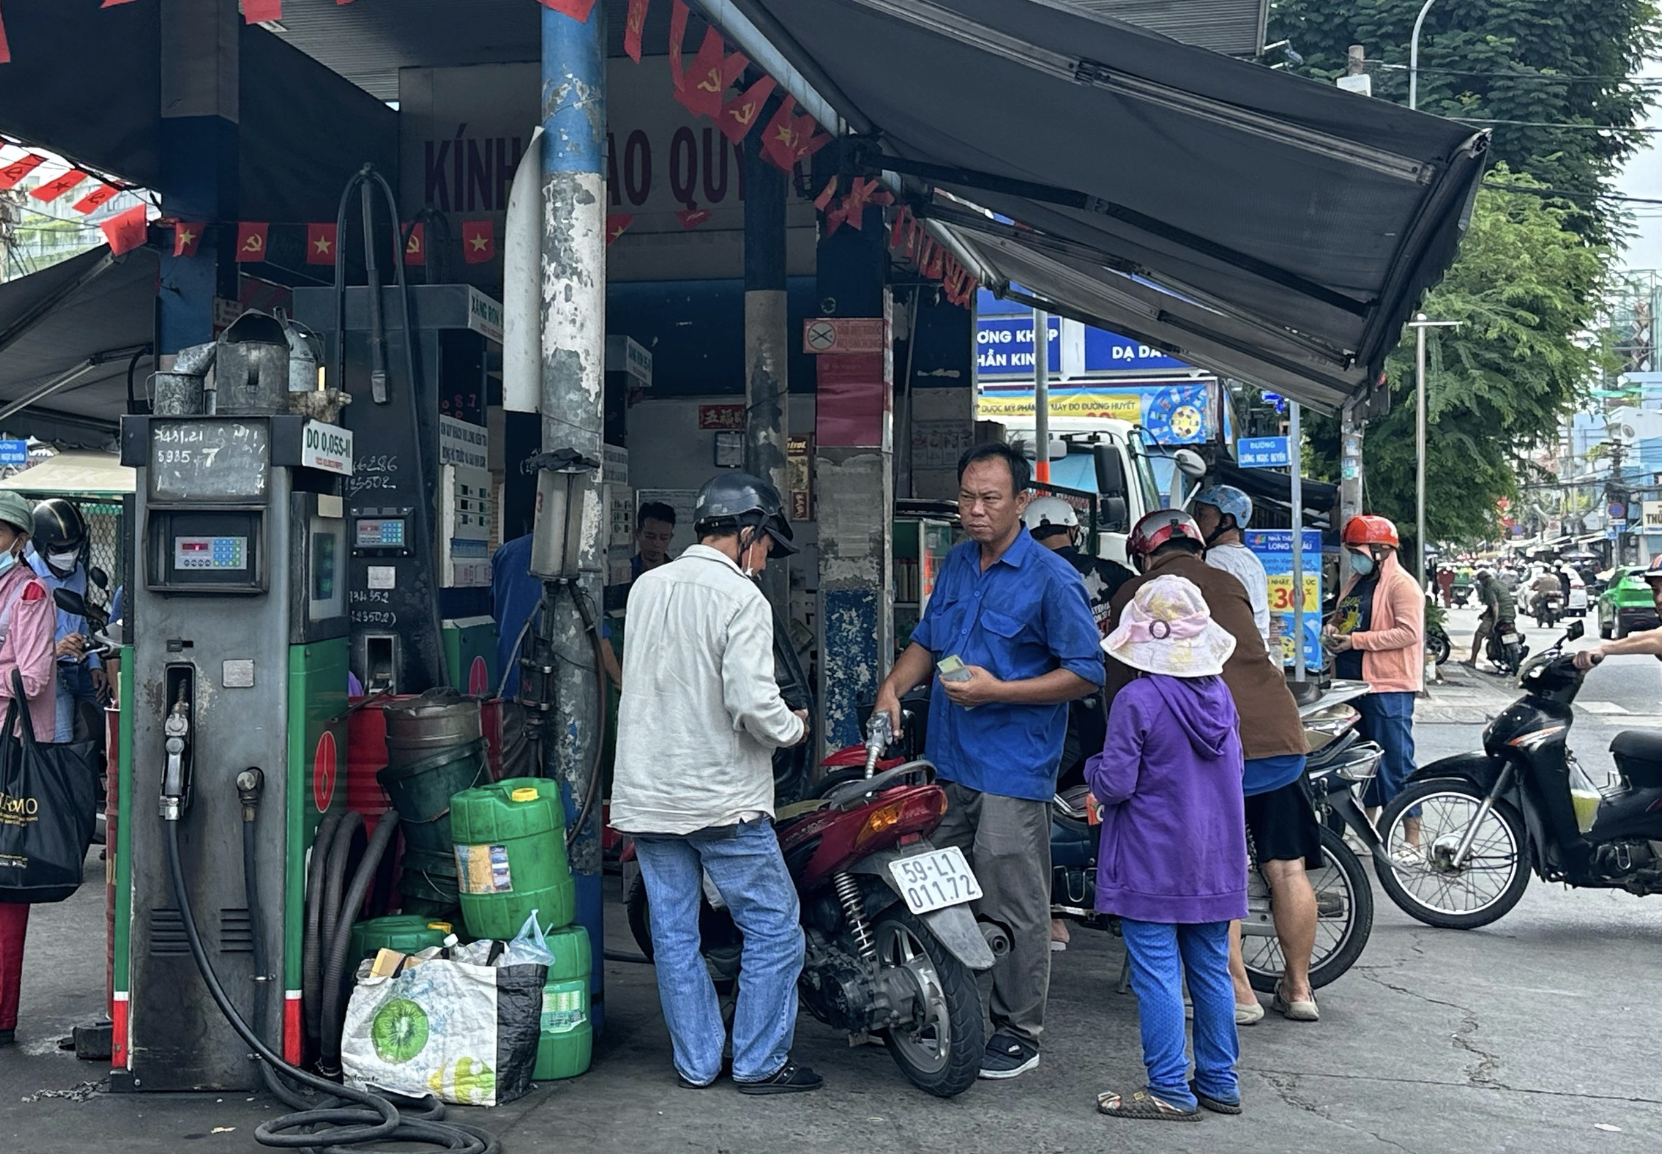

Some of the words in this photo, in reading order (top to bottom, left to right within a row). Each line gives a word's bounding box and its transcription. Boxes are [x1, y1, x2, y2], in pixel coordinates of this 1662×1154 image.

[425, 123, 522, 213] KÍNH
[1016, 329, 1058, 343] KHP
[1112, 345, 1136, 362] DẠ
[306, 427, 320, 451] DO
[1268, 542, 1290, 550] LONG
[902, 853, 956, 883] 59-L1
[908, 875, 975, 908] 011.72
